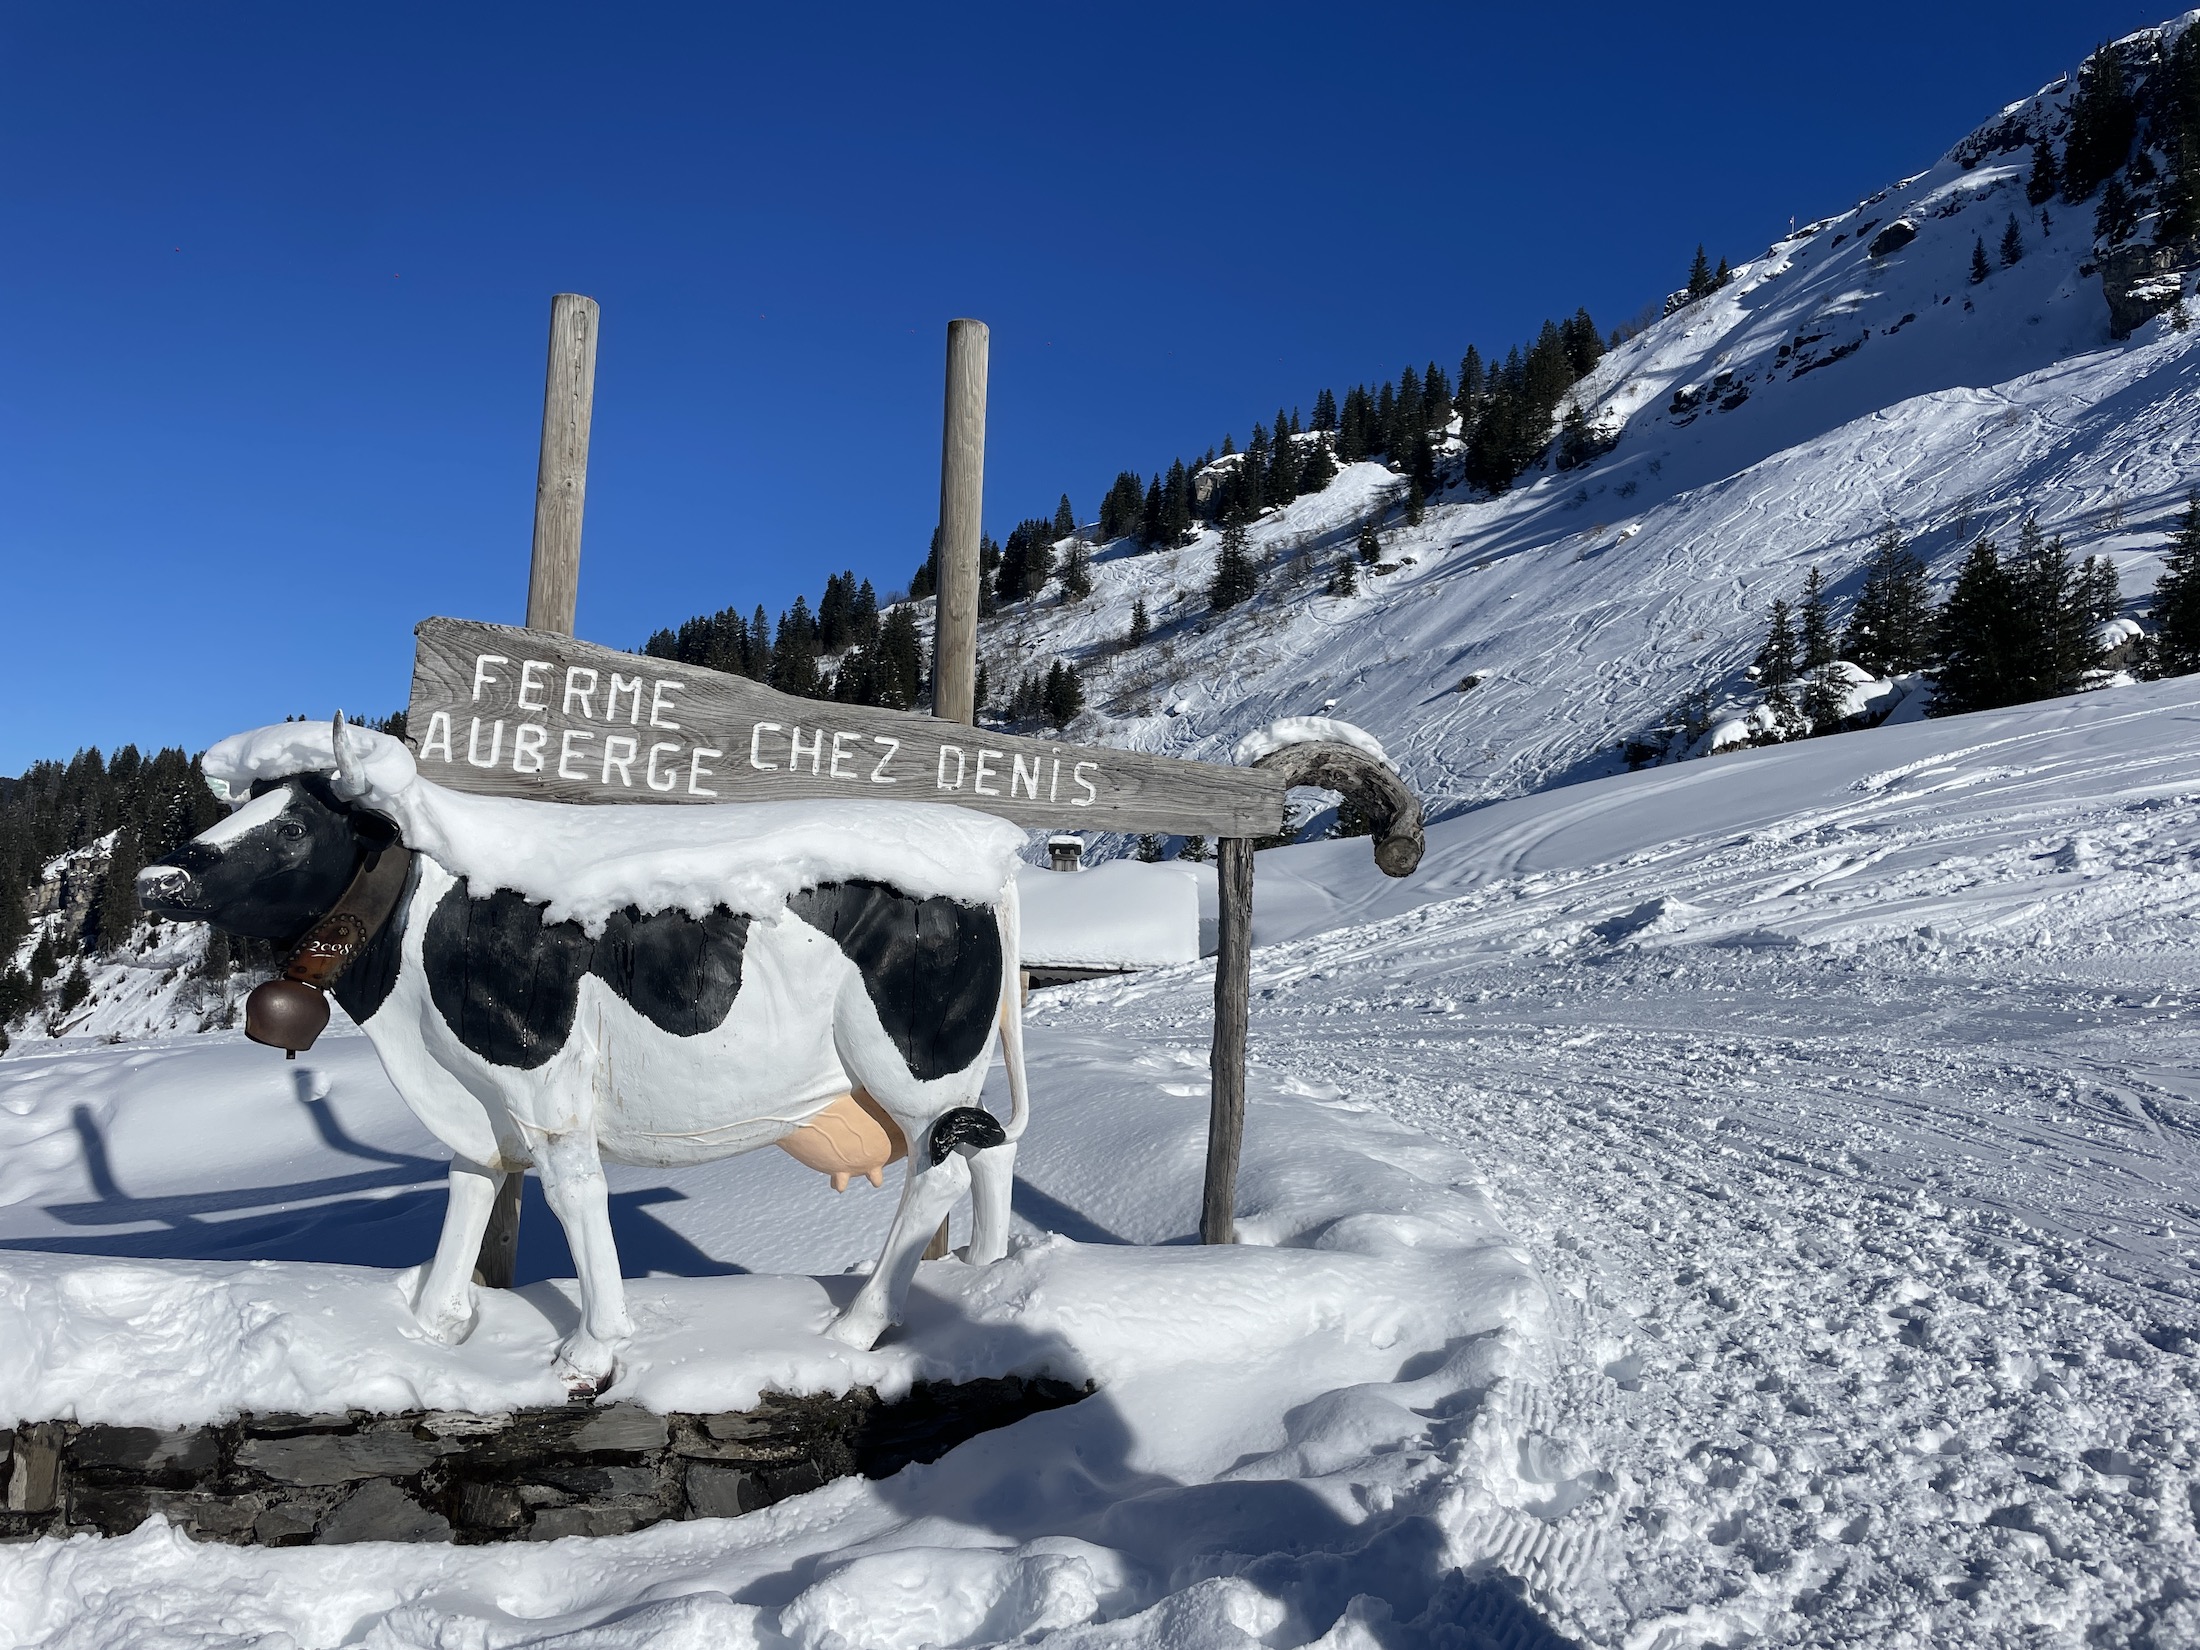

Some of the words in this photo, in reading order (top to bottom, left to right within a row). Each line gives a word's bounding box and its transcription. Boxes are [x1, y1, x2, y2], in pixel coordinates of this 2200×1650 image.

[472, 654, 685, 729] FERME
[419, 711, 723, 797] AUBERGE
[750, 721, 900, 784] CHEZ
[309, 940, 353, 955] 2008
